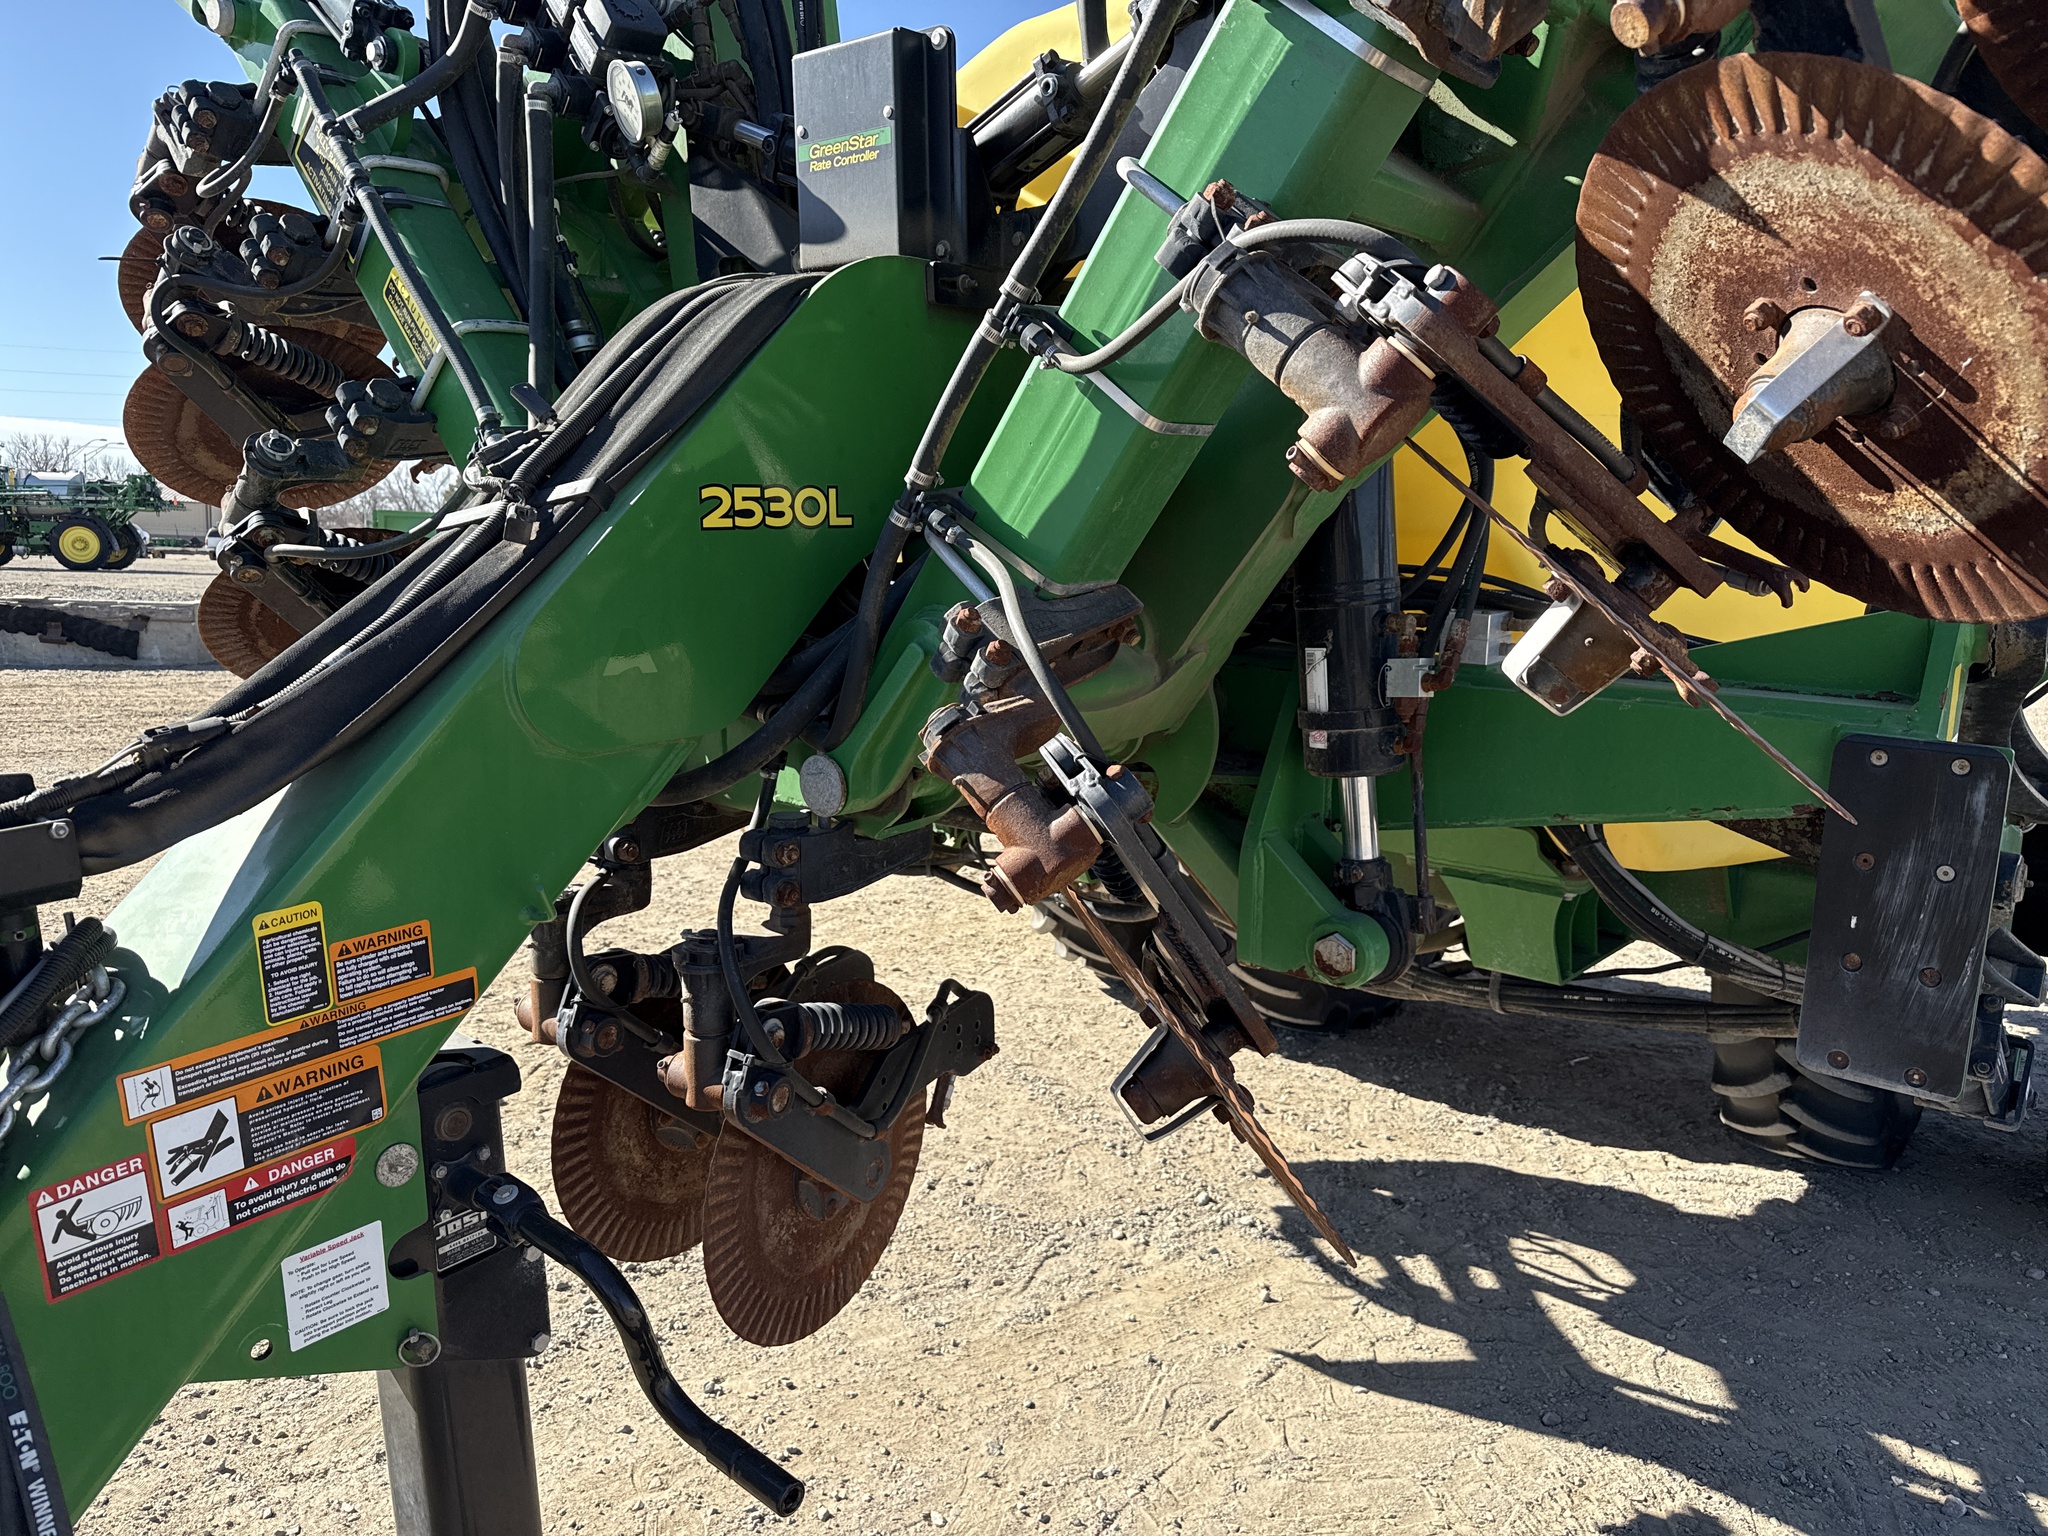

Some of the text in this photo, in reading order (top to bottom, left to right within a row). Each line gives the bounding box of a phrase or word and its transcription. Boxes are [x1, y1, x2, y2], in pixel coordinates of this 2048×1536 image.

[325, 162, 339, 187] MAIN
[809, 150, 879, 172] Rate Controller
[305, 161, 332, 210] ACTIVATING
[319, 168, 335, 198] PRIOR
[386, 295, 406, 323] DAMAGE
[402, 323, 414, 338] MAY
[387, 282, 397, 294] DO
[393, 293, 405, 308] NOT
[401, 307, 413, 324] RUN
[409, 322, 424, 342] PUMP
[398, 282, 437, 349] CAUTION
[700, 484, 853, 530] 2530L
[270, 908, 317, 927] CAUTION
[352, 924, 422, 952] WARNING
[356, 951, 377, 963] cylinder
[387, 943, 410, 954] attaching
[410, 939, 425, 947] hoses
[337, 968, 362, 981] operating
[338, 977, 356, 986] Failure
[386, 965, 399, 973] allow
[399, 960, 415, 970] wings
[345, 963, 357, 972] fully
[357, 958, 378, 969] charged
[396, 948, 413, 957] before
[339, 990, 354, 998] lower
[354, 986, 367, 994] from
[367, 980, 389, 991] transport
[353, 979, 372, 989] rapidly
[372, 975, 386, 983] when
[386, 967, 412, 980] attempting
[309, 1001, 366, 1026] WARNING
[174, 1035, 288, 1076] Do not exceed this implement's maximum
[175, 1069, 202, 1083] transport
[202, 1063, 220, 1074] speed
[235, 1054, 250, 1062] km/h
[250, 1050, 260, 1058] (20
[176, 1076, 207, 1091] Exceeding
[207, 1072, 219, 1080] this
[219, 1066, 237, 1078] speed
[237, 1063, 250, 1072] may
[250, 1057, 266, 1067] result
[273, 1051, 285, 1059] loss
[291, 1043, 311, 1053] control
[311, 1037, 328, 1048] during
[177, 1083, 204, 1097] transport
[212, 1074, 234, 1086] braking
[234, 1070, 245, 1078] and
[246, 1063, 266, 1074] serious
[266, 1058, 283, 1068] injury
[273, 1054, 364, 1096] WARNING
[57, 1158, 143, 1199] DANGER
[268, 1146, 335, 1182] DANGER
[234, 1160, 346, 1210] To avoid injury or death do
[235, 1207, 251, 1220] not
[251, 1194, 285, 1214] contact
[285, 1181, 317, 1200] electric
[56, 1231, 139, 1269] Avoid serious injury
[57, 1269, 67, 1277] or
[67, 1259, 89, 1273] death
[89, 1251, 109, 1264] from
[59, 1248, 138, 1285] Do not adjust while
[60, 1273, 98, 1293] machine
[98, 1269, 107, 1277] is
[108, 1265, 118, 1274] in
